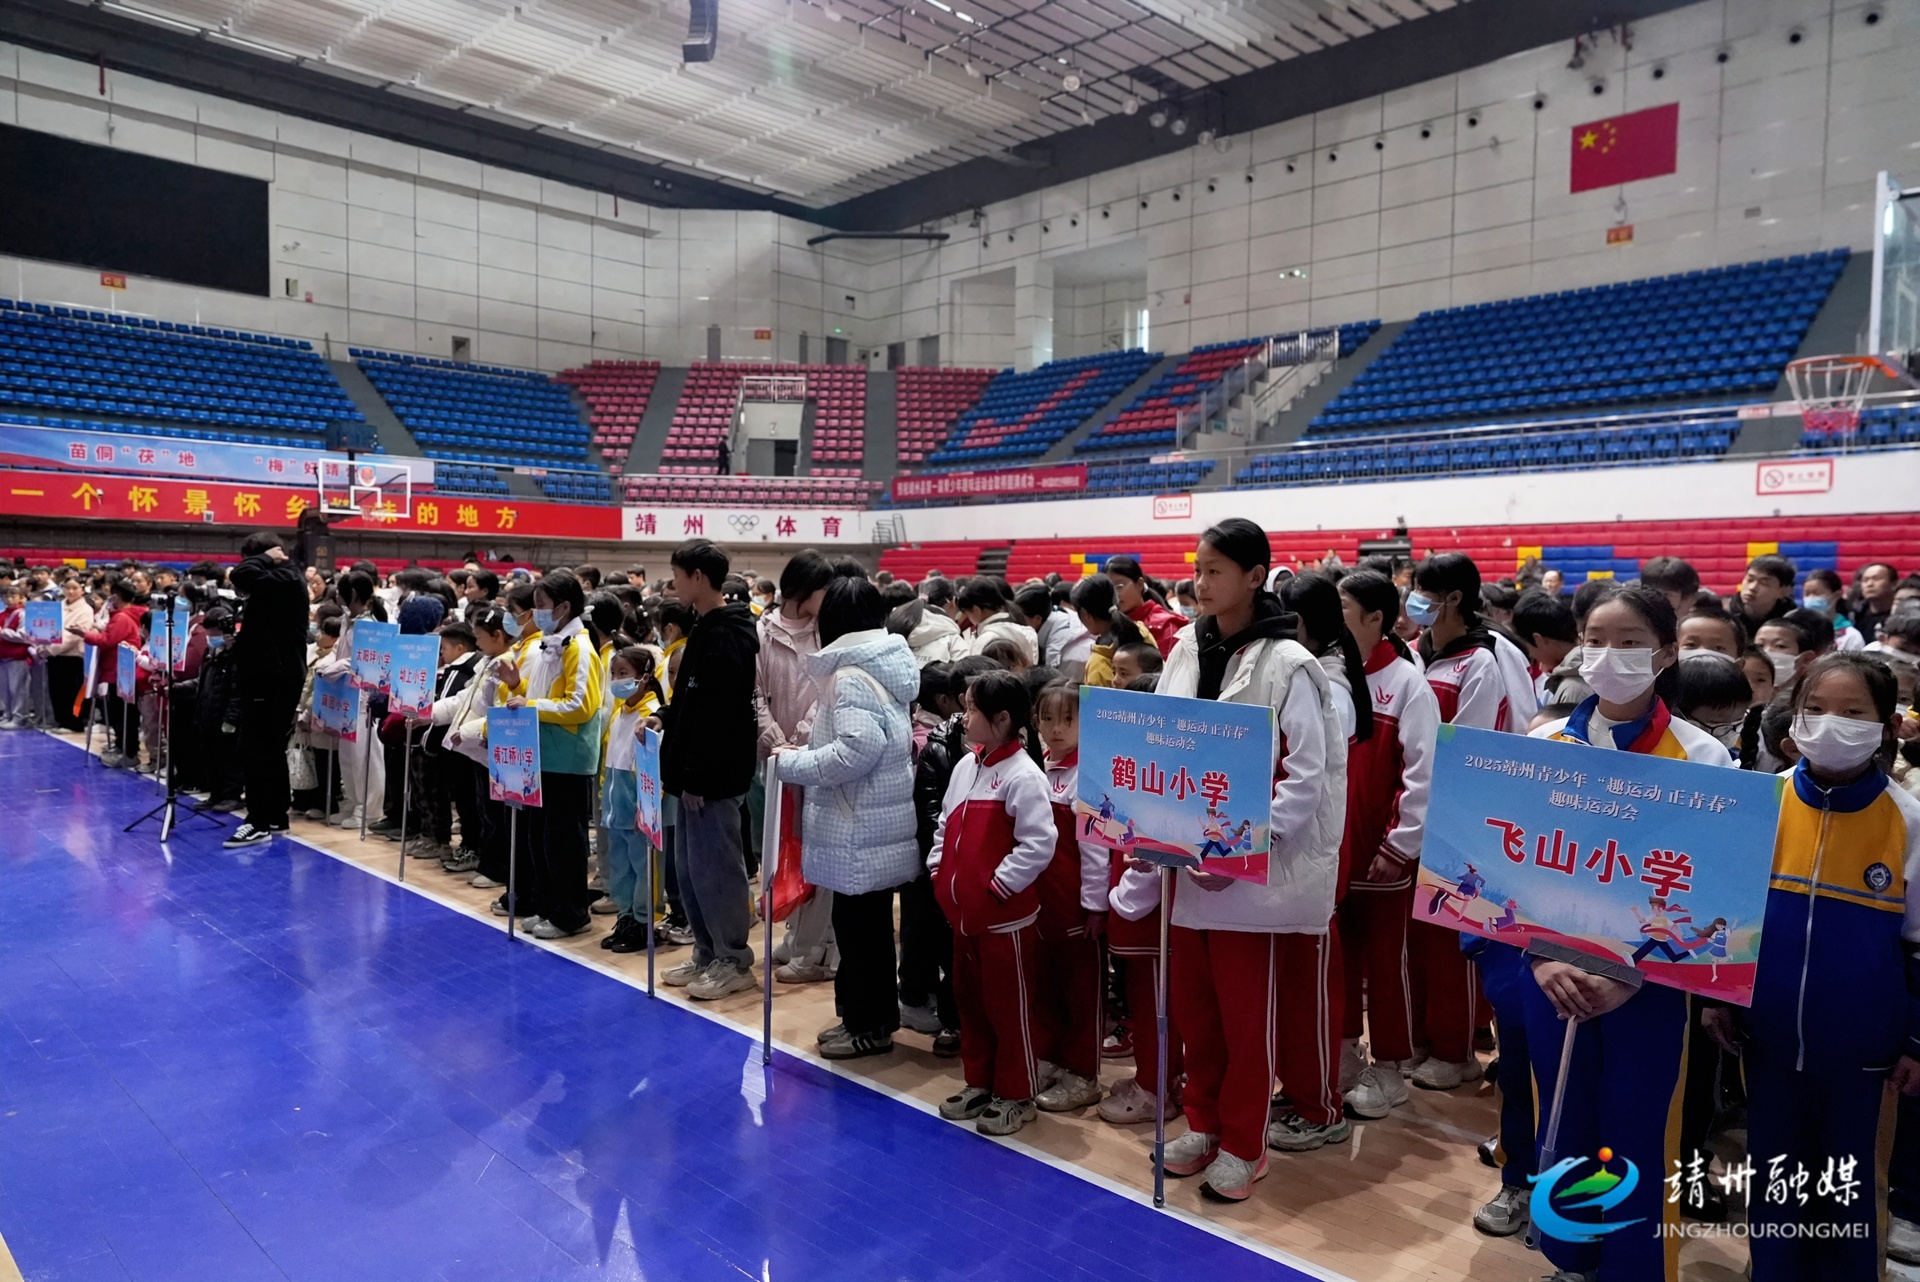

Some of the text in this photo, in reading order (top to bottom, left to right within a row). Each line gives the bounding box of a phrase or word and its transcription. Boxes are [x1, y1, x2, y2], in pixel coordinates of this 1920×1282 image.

[635, 513, 843, 538] 靖州 体育
[1146, 731, 1196, 750] 趣味运动会
[1111, 755, 1230, 808] 鹤山小学
[1548, 789, 1639, 822] 趣味运动会
[1485, 817, 1694, 898] 飞山小学
